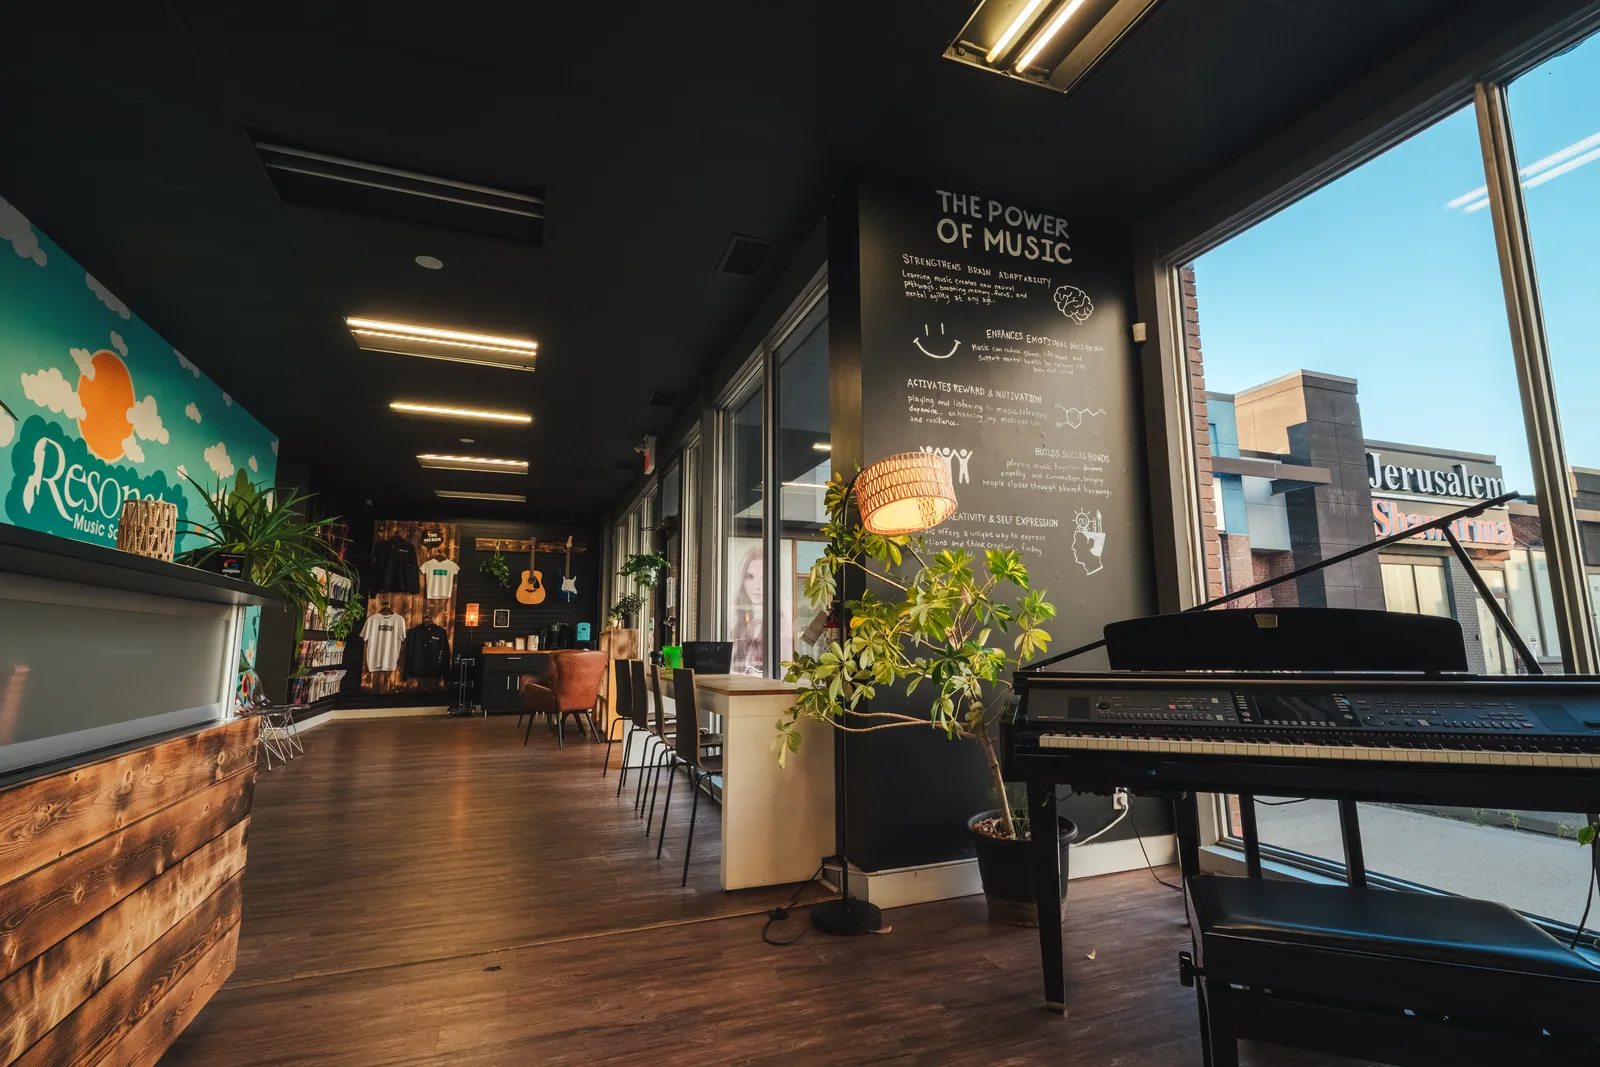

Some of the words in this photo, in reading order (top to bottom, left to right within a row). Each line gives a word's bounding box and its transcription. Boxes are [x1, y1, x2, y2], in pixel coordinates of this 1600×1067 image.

[936, 190, 982, 219] THE
[988, 200, 1070, 239] POWER
[936, 218, 973, 249] OF
[984, 227, 1073, 265] MUSIC
[901, 269, 931, 284] Learning
[934, 276, 953, 284] music
[902, 253, 961, 271] STRENGTHENS
[967, 265, 991, 276] BRAIN
[998, 271, 1051, 289] ADAPTABILITY
[905, 291, 927, 299] mental
[967, 296, 979, 305] any
[971, 343, 990, 351] Music
[986, 329, 1024, 341] ENHANCES
[1026, 335, 1068, 348] EMOTIONAL
[1069, 342, 1104, 352] WELLBEING
[907, 378, 952, 393] ACTIVATES
[952, 383, 985, 396] REWARD
[987, 389, 994, 398] &
[995, 390, 1042, 404] MOTIVATION
[937, 399, 950, 407] and
[953, 398, 983, 413] listening
[986, 403, 994, 411] to
[996, 406, 1018, 415] music
[1019, 407, 1048, 420] releases
[948, 409, 984, 424] enhancing
[909, 415, 923, 424] and
[1034, 447, 1060, 458] BUILDS
[1061, 450, 1087, 460] SOCIAL
[1087, 453, 1111, 463] BONDS
[1006, 458, 1030, 471] playing
[1054, 462, 1080, 473] together
[1000, 470, 1026, 480] empathy
[1083, 474, 1104, 487] bringing
[1368, 452, 1507, 499] Jerusalem
[981, 478, 1005, 489] people
[1007, 480, 1029, 488] closer
[1030, 481, 1057, 493] through
[1058, 483, 1081, 492] shared
[73, 513, 106, 537] Music
[949, 511, 986, 522] EATIVITY
[988, 514, 996, 524] &
[996, 515, 1014, 525] SELF
[1015, 516, 1058, 528] EXPRESSION
[937, 527, 960, 538] offers
[969, 530, 993, 541] unique
[995, 532, 1009, 541] way
[1010, 531, 1019, 539] to
[1020, 534, 1047, 543] express
[951, 540, 965, 548] and
[966, 539, 986, 548] think
